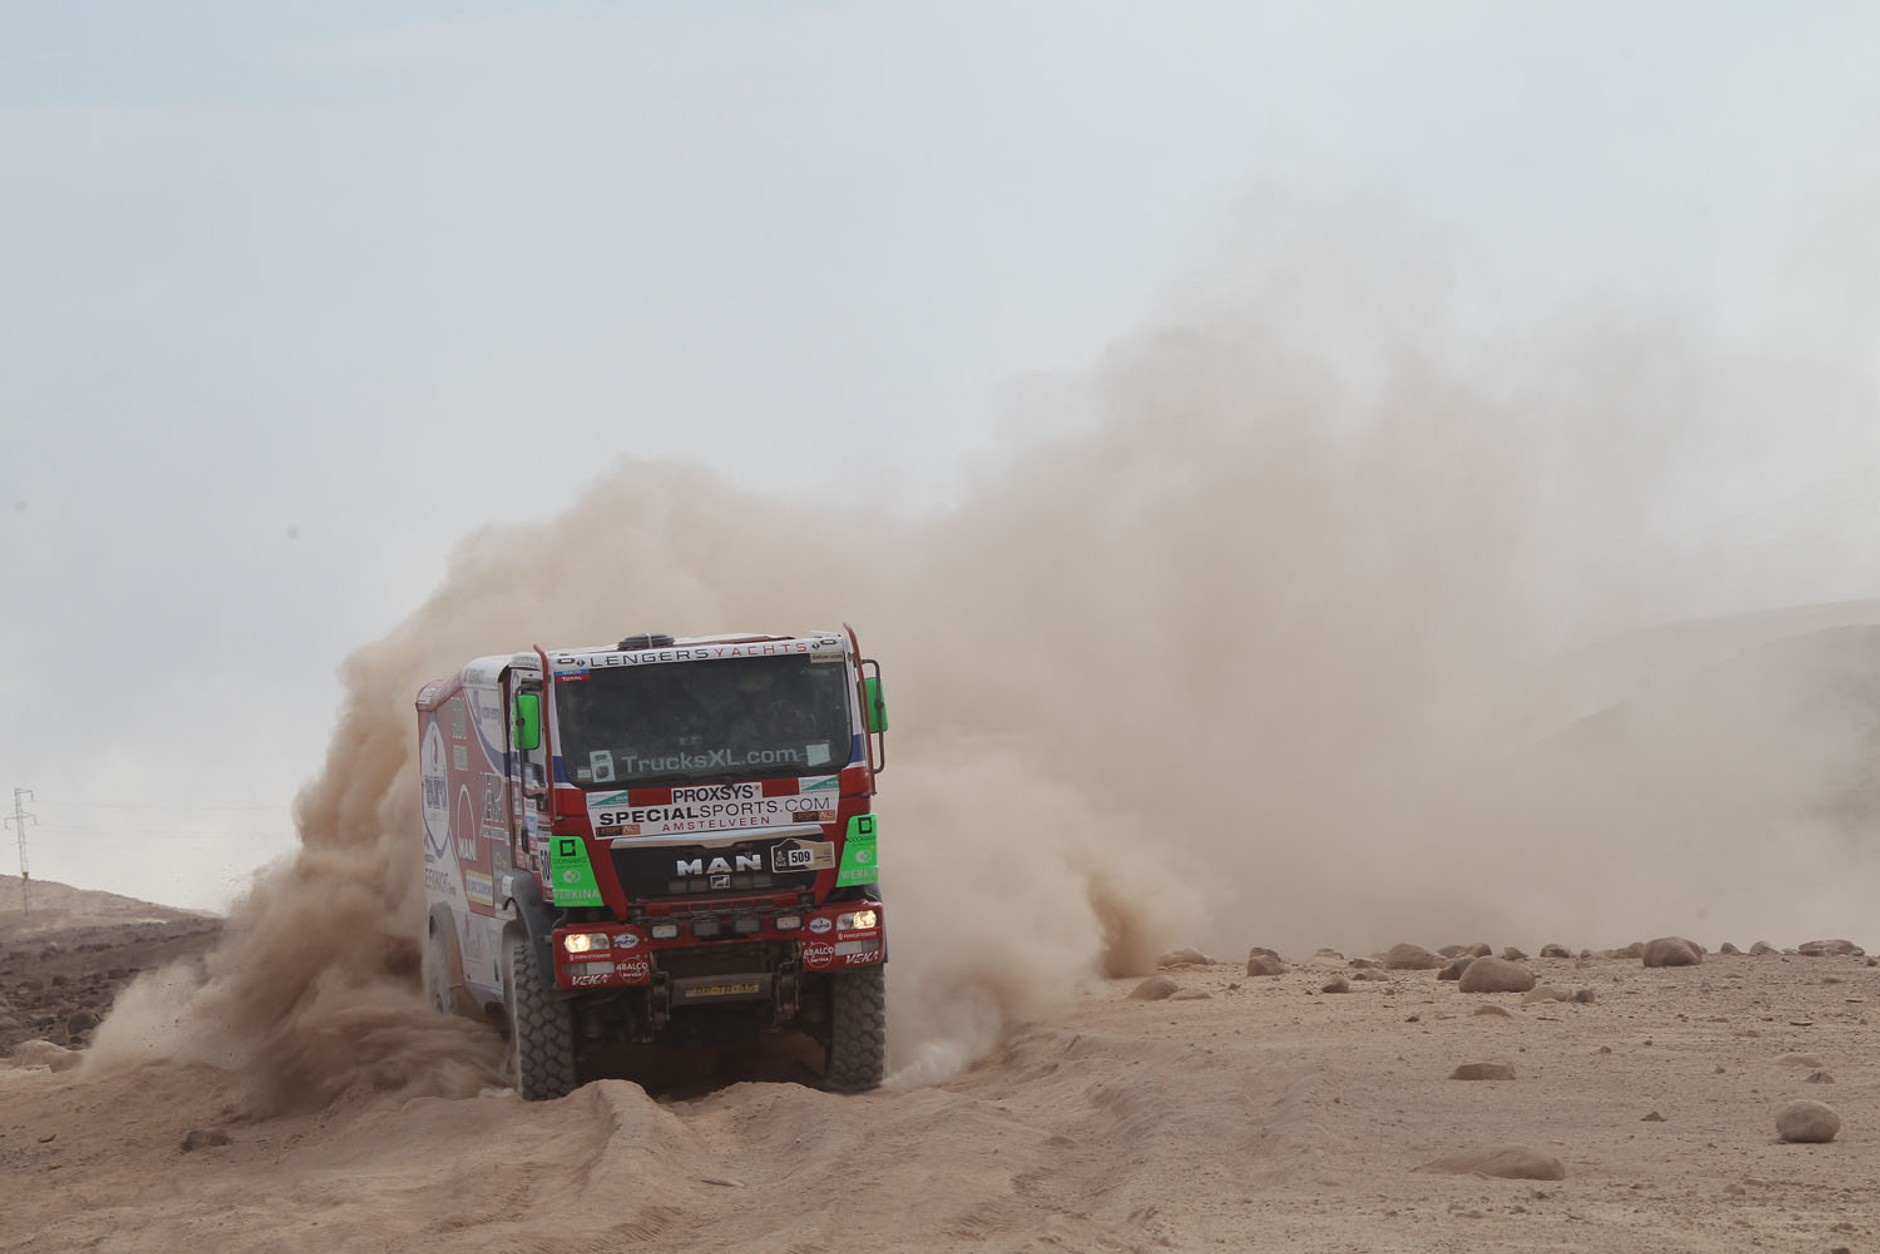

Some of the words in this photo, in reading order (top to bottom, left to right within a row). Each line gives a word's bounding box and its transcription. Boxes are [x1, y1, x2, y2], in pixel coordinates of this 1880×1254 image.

[621, 748, 798, 773] TrucksXL.com
[673, 784, 754, 804] PROXSYS
[662, 816, 770, 832] AMSTELVEEN
[791, 851, 811, 864] 509
[676, 854, 762, 877] MAN
[845, 951, 879, 964] VEKA
[616, 961, 648, 971] ABALCO
[571, 973, 609, 986] VEKA
